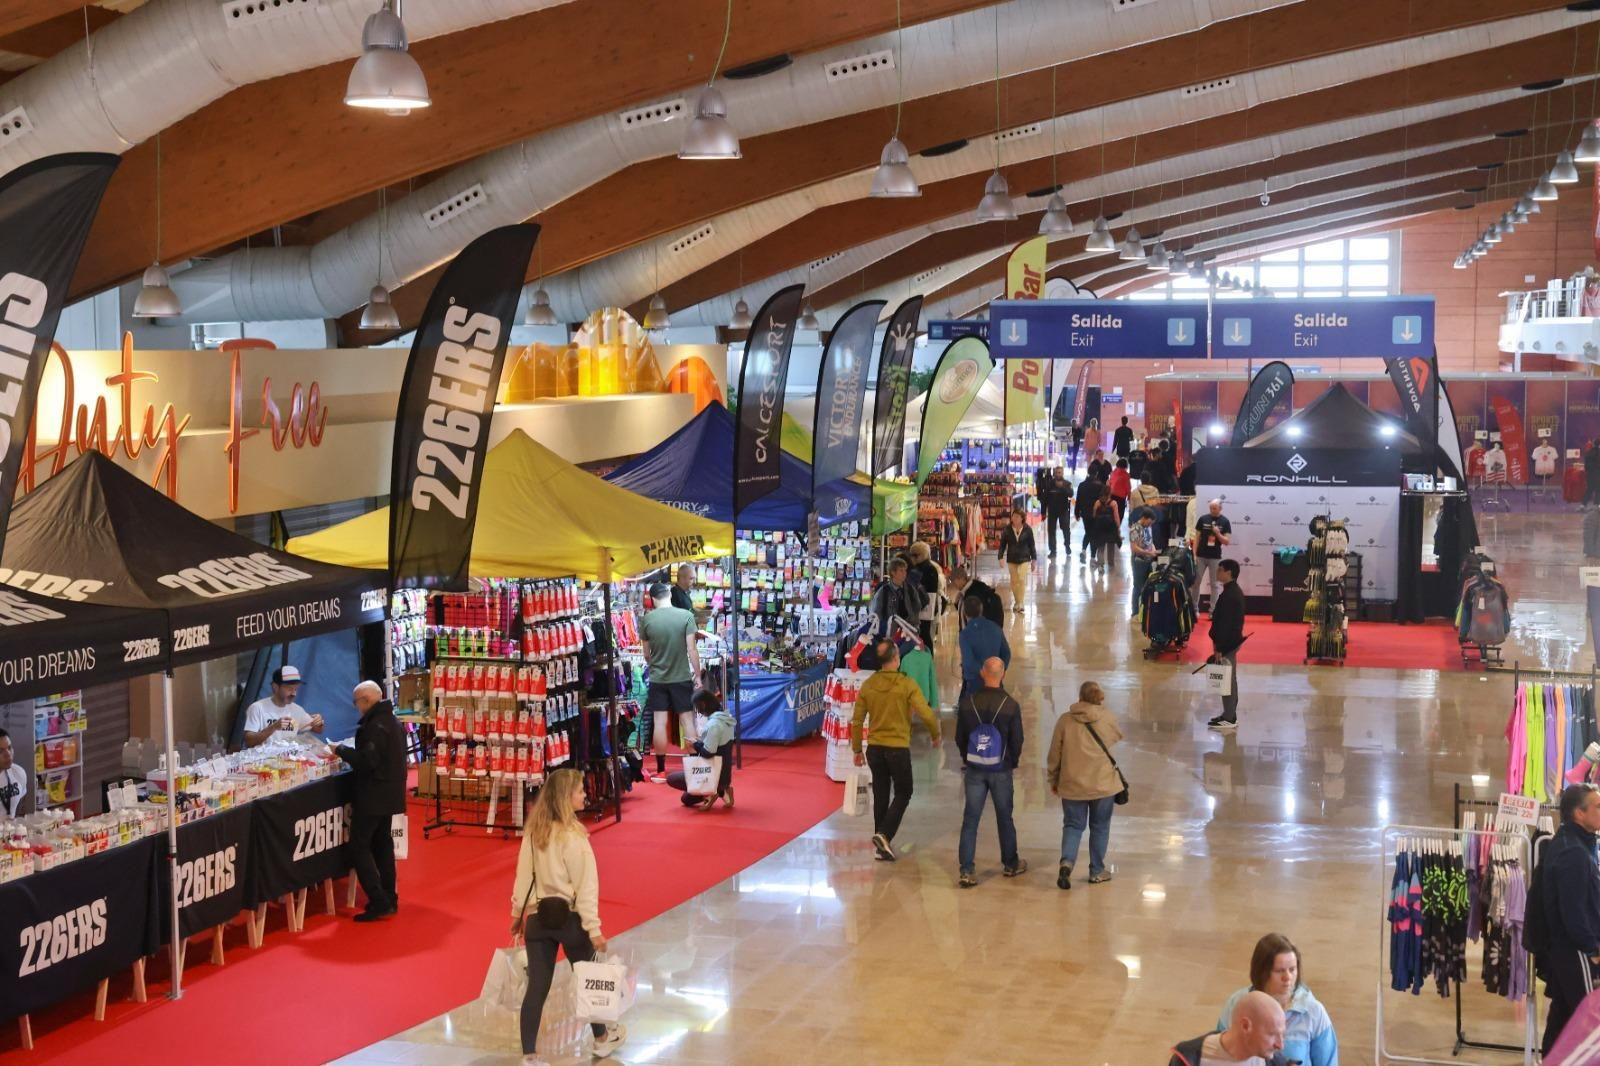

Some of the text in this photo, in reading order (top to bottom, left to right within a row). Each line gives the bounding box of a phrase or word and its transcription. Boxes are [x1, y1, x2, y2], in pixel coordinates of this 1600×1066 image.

[1071, 314, 1122, 329] Salida
[1294, 312, 1348, 328] Salida
[1071, 332, 1095, 347] Exit
[1294, 332, 1318, 347] Exit
[17, 331, 190, 500] Duty
[218, 338, 329, 514] Free
[412, 304, 501, 520] 226ERS
[1246, 475, 1347, 483] RONHILL
[157, 552, 313, 599] 226ERS
[361, 588, 388, 612] 226ERS
[237, 597, 341, 639] FEED YOUR DREAMS
[174, 624, 210, 652] 226ERS
[0, 646, 96, 686] OUR DREAMS
[293, 802, 353, 862] 226ERS
[19, 897, 107, 978] 226ERS
[585, 978, 615, 992] 226ERS
